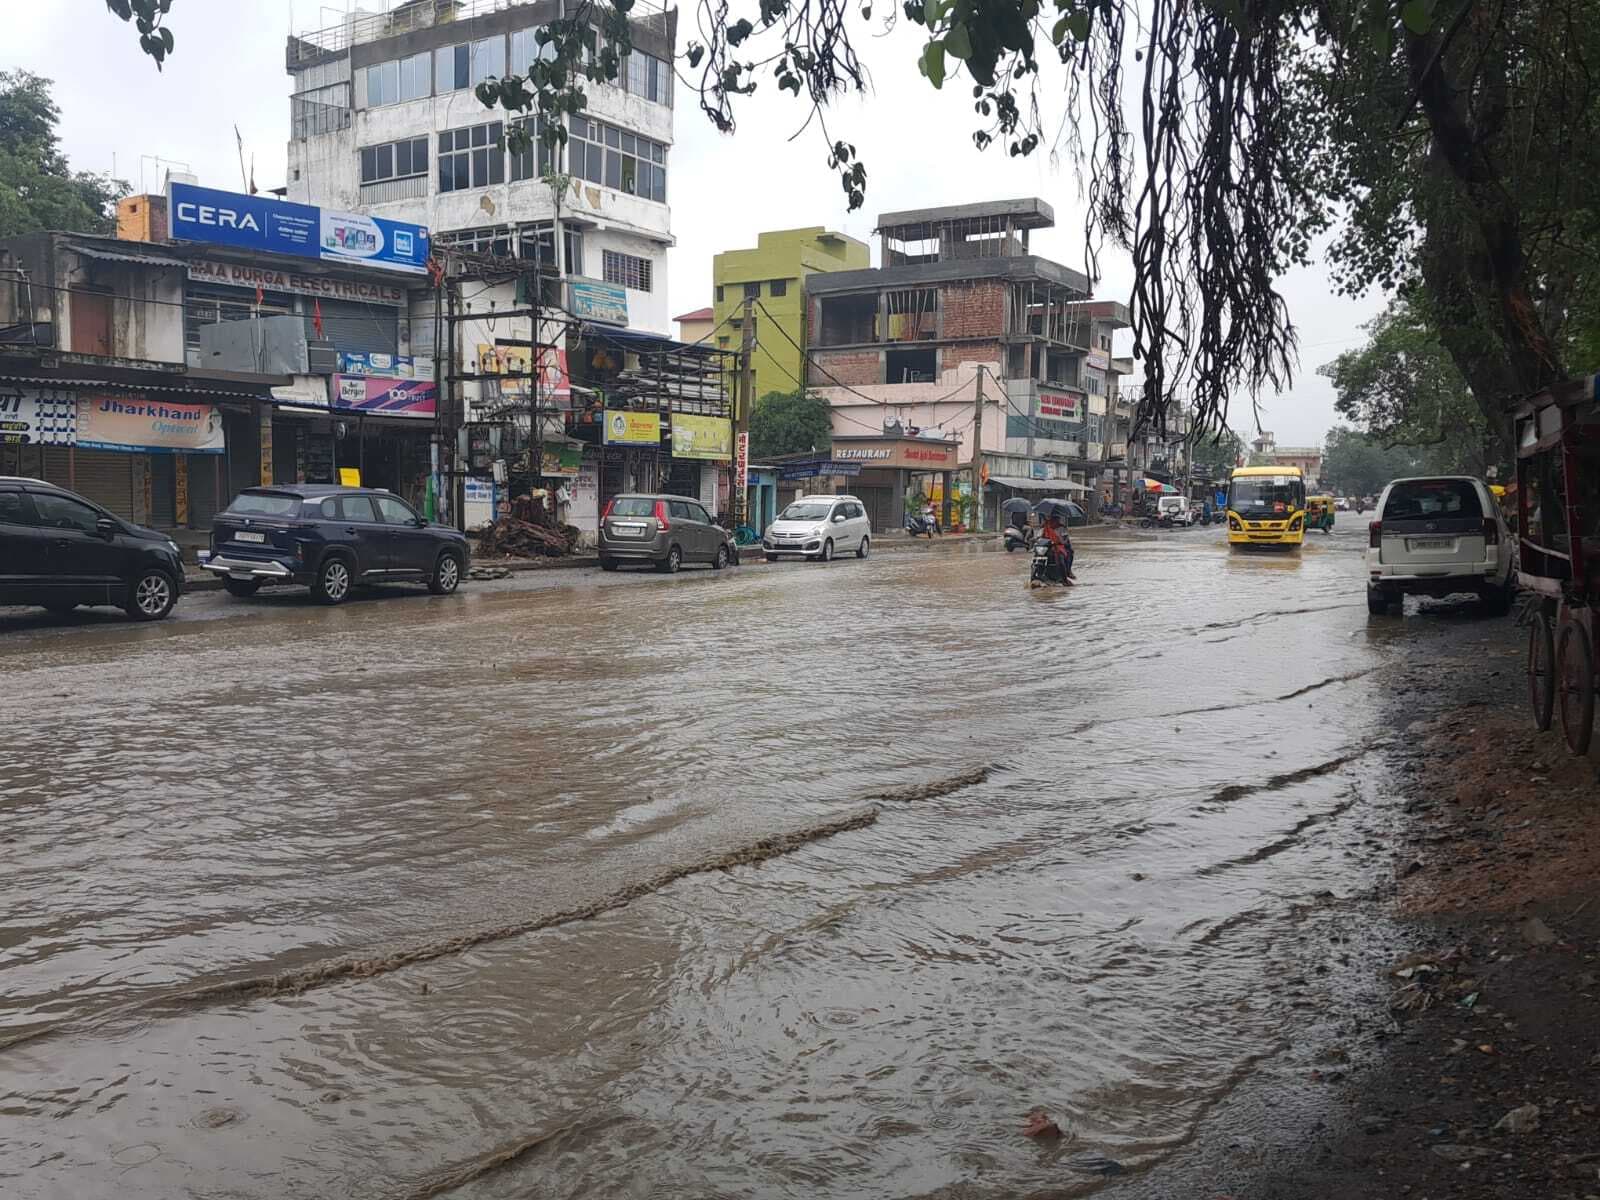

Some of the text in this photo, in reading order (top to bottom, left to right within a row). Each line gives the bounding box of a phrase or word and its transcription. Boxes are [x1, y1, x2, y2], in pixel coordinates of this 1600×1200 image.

[177, 202, 260, 232] CERA
[231, 265, 285, 286] DURGA
[289, 275, 401, 300] ELECTRICALS
[341, 386, 365, 397] Berger
[100, 400, 201, 421] Jharkhand
[836, 449, 892, 460] RESTAURANT
